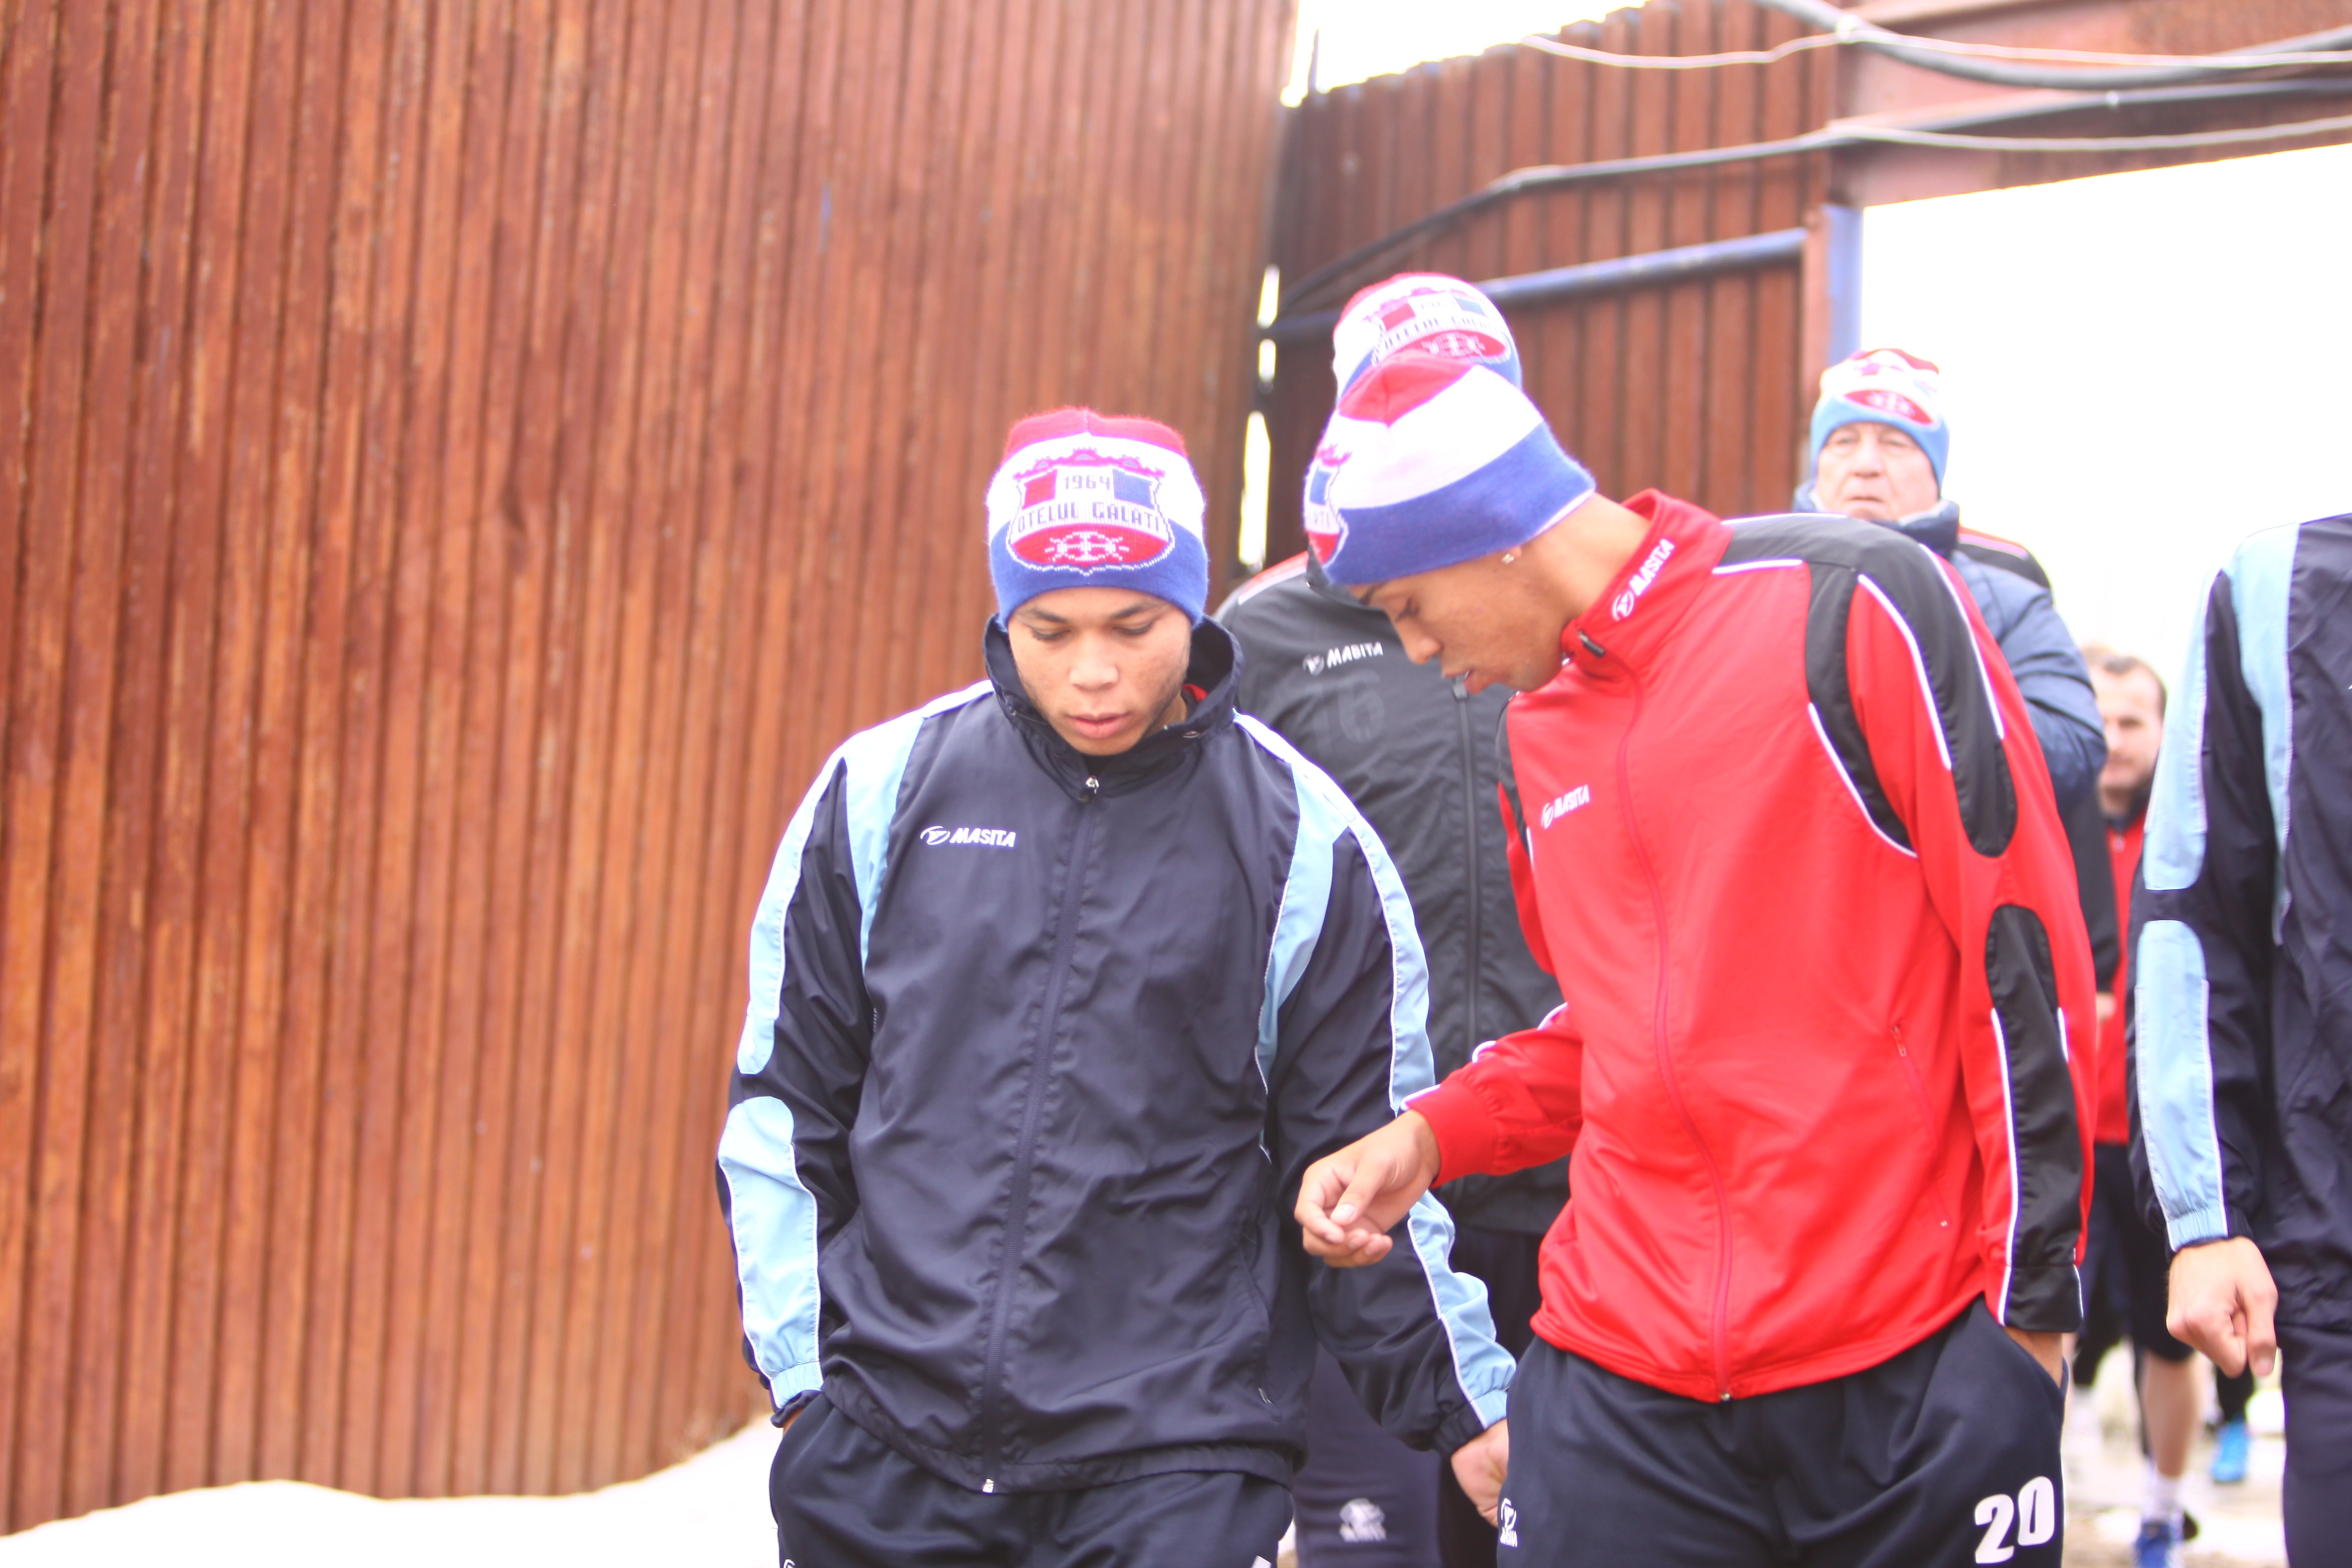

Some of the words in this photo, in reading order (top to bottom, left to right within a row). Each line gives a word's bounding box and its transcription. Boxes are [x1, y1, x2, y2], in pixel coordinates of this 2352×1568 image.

[1062, 475, 1110, 490] 1964
[1018, 501, 1079, 533] OTELUL
[1092, 501, 1159, 533] GALATI
[1629, 538, 1675, 596] MASITA
[949, 827, 1017, 848] MASITA
[1974, 1475, 2055, 1564] 20
